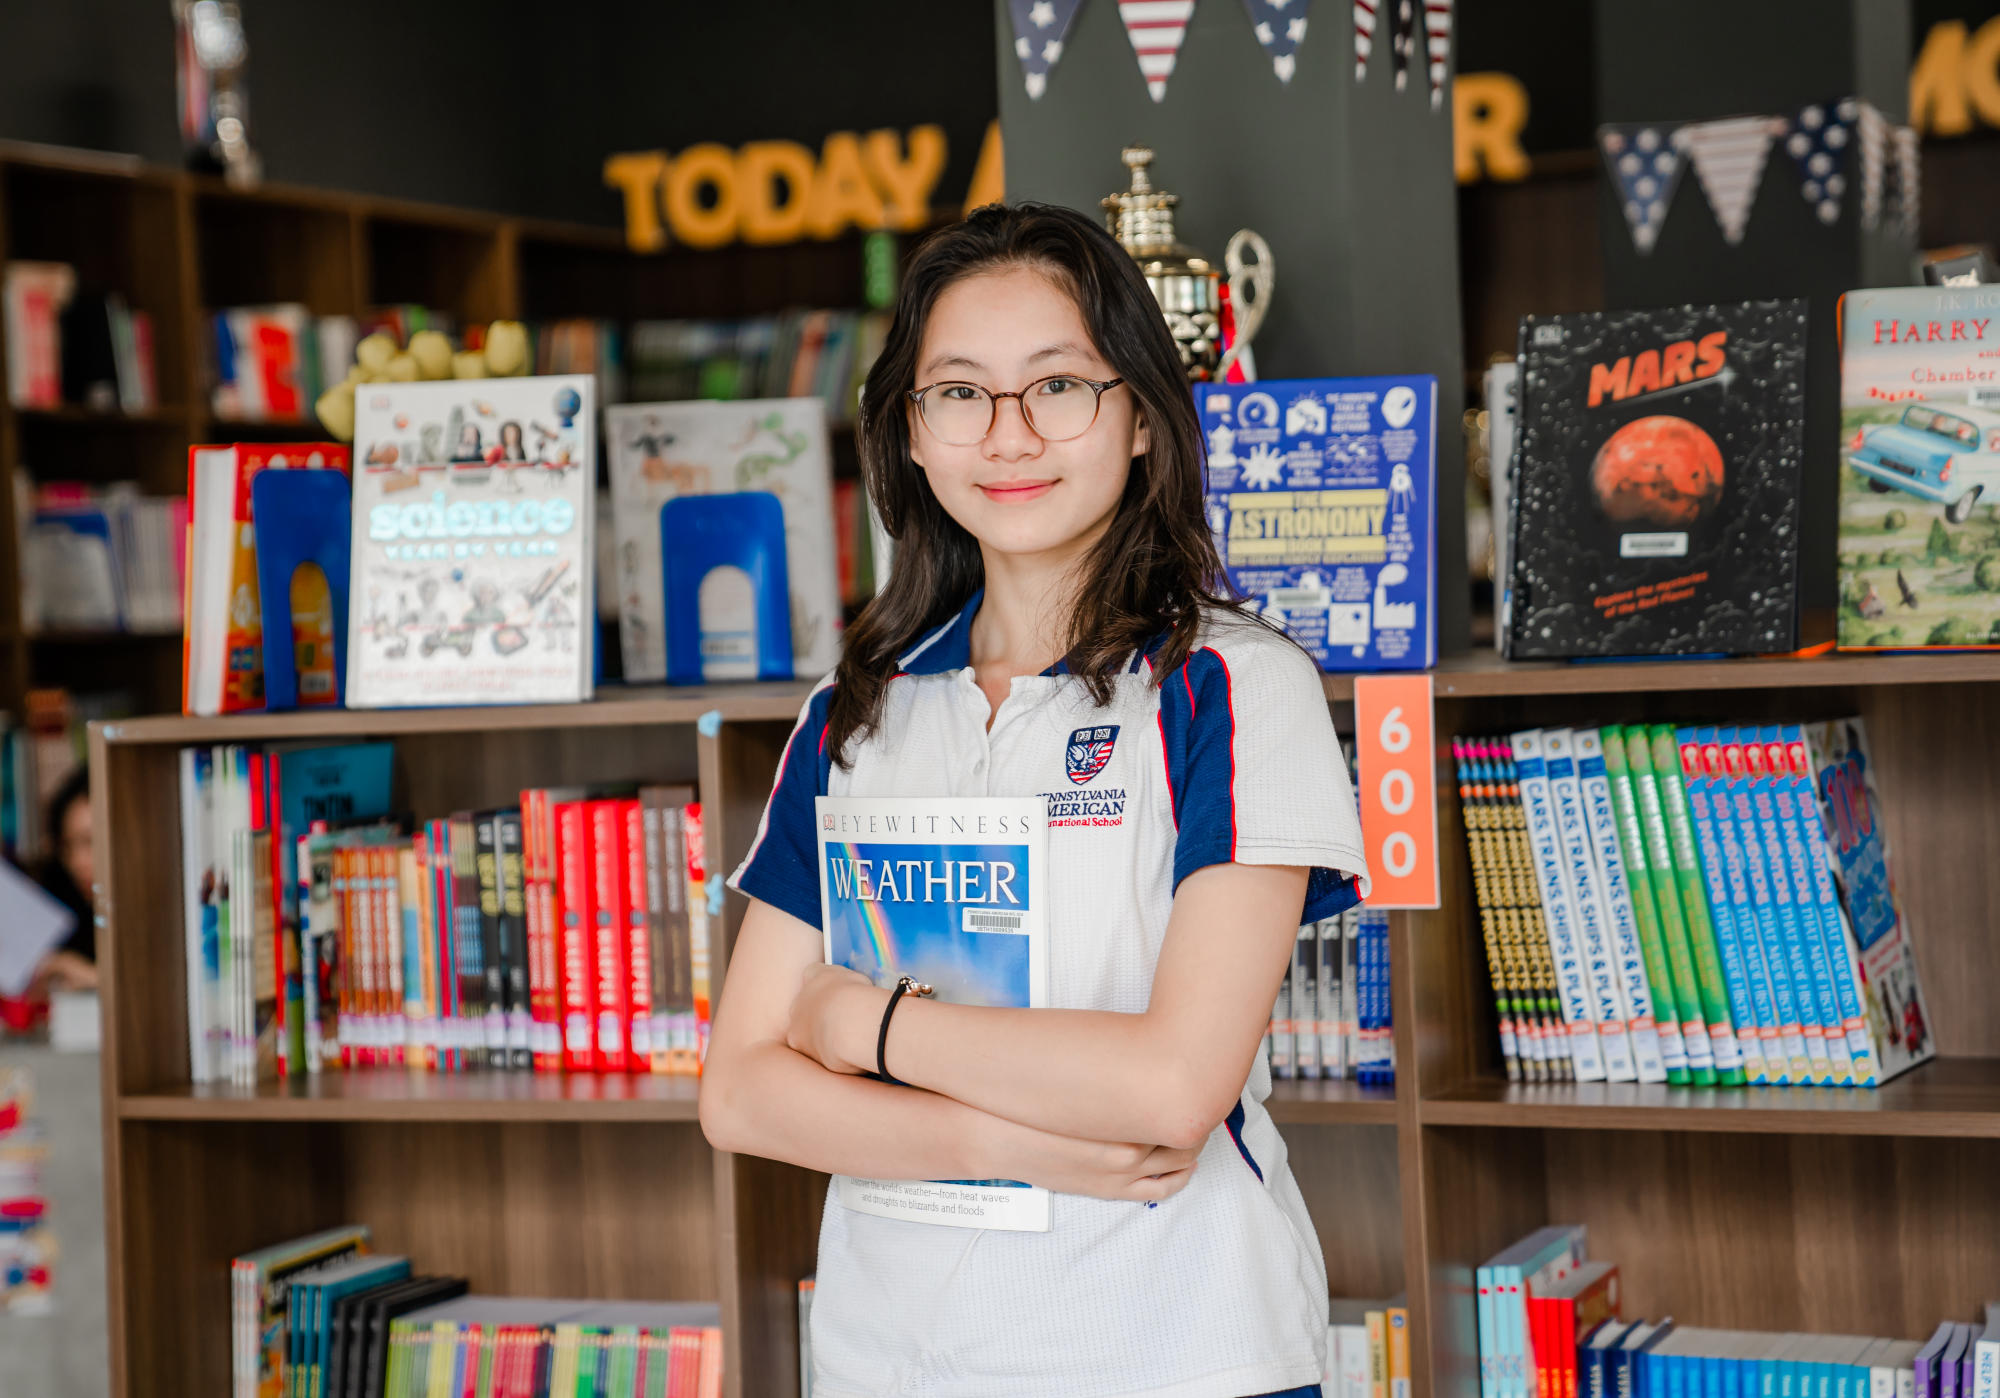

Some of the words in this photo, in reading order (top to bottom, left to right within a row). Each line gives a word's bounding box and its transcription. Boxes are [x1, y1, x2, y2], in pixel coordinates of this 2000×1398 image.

[603, 124, 947, 254] TODAY
[1873, 319, 1990, 344] HARRY
[1587, 331, 1727, 408] MARS
[1911, 366, 1996, 383] Chamber
[369, 490, 574, 541] science
[1228, 506, 1386, 539] ASTRONOMY
[1036, 788, 1126, 803] NNSYLVANIA
[1048, 800, 1125, 817] MERICAN
[1379, 706, 1417, 878] 600
[1691, 792, 1710, 819] 100
[1712, 792, 1731, 819] 100
[1734, 792, 1753, 819] 100
[1754, 792, 1773, 819] 100
[1776, 792, 1794, 819] 100
[1798, 792, 1815, 819] 100
[841, 814, 1030, 833] EYEWITNESS
[1048, 818, 1090, 828] rnational
[1092, 816, 1122, 827] School
[1698, 819, 1727, 904] INVENTIONS
[1718, 819, 1747, 904] INVENTIONS
[1741, 819, 1770, 904] INVENTIONS
[1762, 819, 1791, 904] INVENTIONS
[1783, 819, 1811, 904] INVENTIONS
[1804, 819, 1833, 904] INVENTIONS
[830, 858, 1020, 904] WEATHER
[1552, 904, 1573, 956] SHIPS
[1580, 904, 1602, 956] SHIPS
[1613, 903, 1636, 956] SHIPS
[1562, 958, 1576, 971] &
[1591, 958, 1606, 971] &
[1624, 958, 1638, 971] &
[1565, 973, 1587, 1020] PLAN
[1595, 973, 1618, 1020] PLAN
[1626, 973, 1648, 1018] PLAN
[873, 1195, 898, 1208] droughts
[900, 1199, 907, 1208] to
[908, 1199, 939, 1212] blizzards
[941, 1203, 955, 1214] and
[958, 1203, 985, 1216] floods
[960, 1189, 978, 1201] heat
[981, 1194, 1010, 1203] waves
